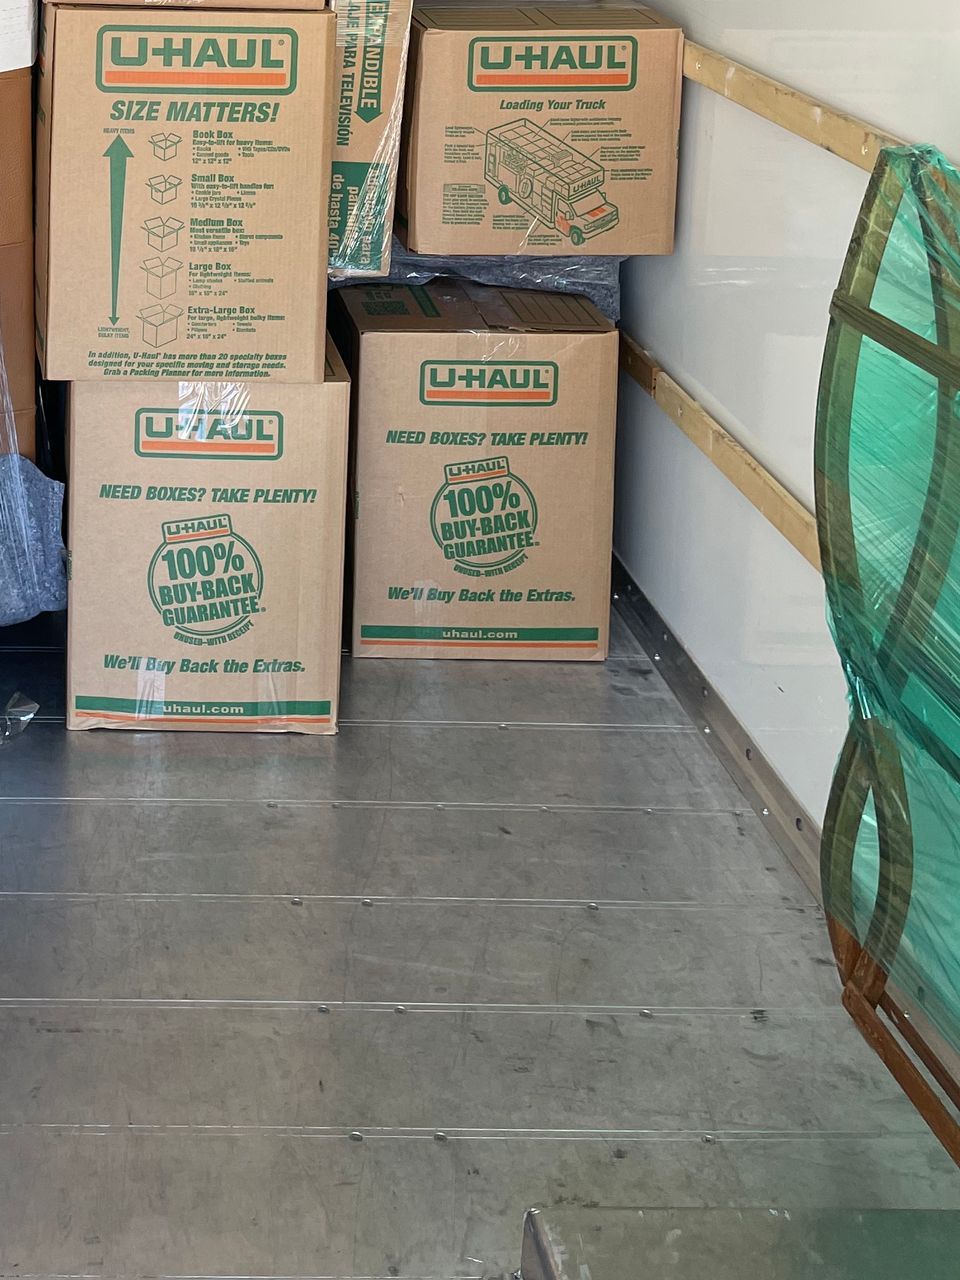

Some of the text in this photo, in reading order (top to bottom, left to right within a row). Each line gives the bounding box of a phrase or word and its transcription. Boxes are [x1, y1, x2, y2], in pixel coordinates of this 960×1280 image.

[111, 36, 284, 69] U-HAUL
[342, 33, 359, 70] PARA
[361, 1, 387, 109] EXPANDIBLE
[480, 45, 626, 69] U-HAUL
[110, 100, 280, 122] SIZE MATTERS!
[336, 73, 355, 147] TELEVISIÓN
[499, 100, 606, 112] Loading Your Truck
[193, 130, 233, 139] Book Box
[191, 174, 234, 182] Small Box
[332, 174, 344, 190] de
[329, 194, 343, 229] hasta
[190, 218, 243, 226] Medium Box
[189, 262, 213, 271] Large
[188, 306, 255, 315] Extra-Large Box
[88, 360, 122, 368] designed
[156, 361, 185, 369] specific
[98, 351, 131, 360] addition,
[230, 353, 263, 361] specialty
[103, 368, 121, 376] Grab
[129, 369, 159, 377] Packing
[161, 369, 190, 377] Planner
[429, 367, 550, 389] U-HAUL
[385, 430, 589, 446] NEED BOXES? TAKE PLENTY!
[99, 484, 318, 504] NEED BOXES? TAKE PLENTY!
[443, 481, 521, 519] 100%
[440, 510, 531, 541] BUY-BACK
[161, 541, 245, 582] 100%
[158, 573, 256, 607] BUY-BACK
[388, 586, 576, 604] We'll Buy Back the Extras.
[442, 628, 518, 640] uhaul.com
[103, 654, 305, 676] We'll Buy Back the Extras.
[161, 704, 244, 715] uhaul.com
